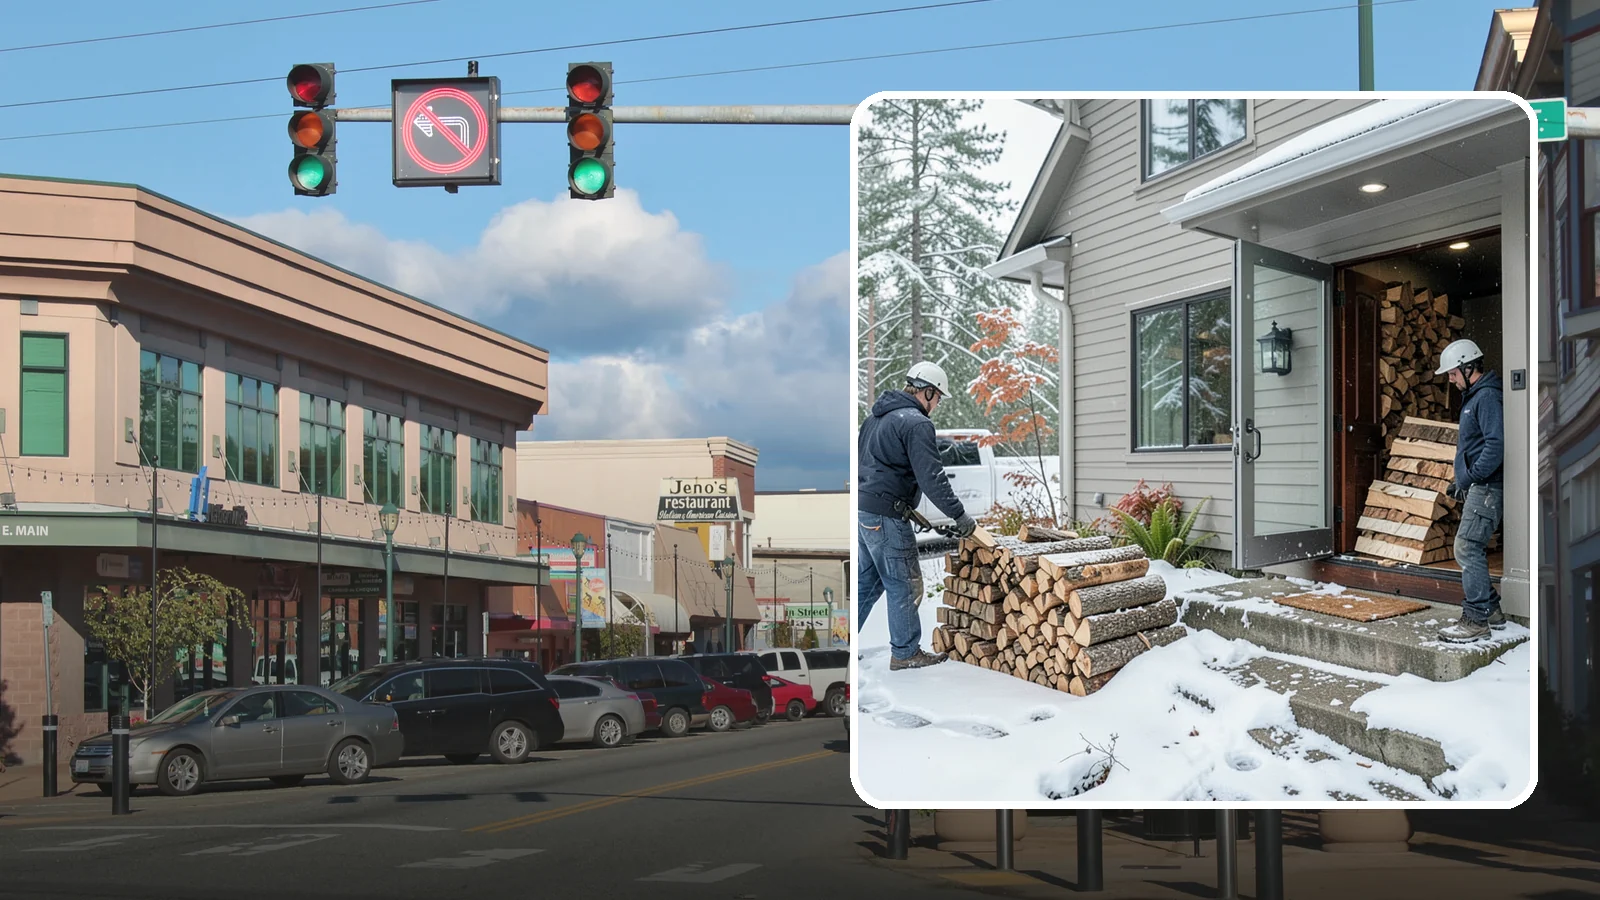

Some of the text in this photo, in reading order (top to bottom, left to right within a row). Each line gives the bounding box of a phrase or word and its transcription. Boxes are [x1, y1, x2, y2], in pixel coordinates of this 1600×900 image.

[670, 480, 727, 494] Jeno's
[665, 496, 731, 509] restaurant
[658, 509, 682, 520] Italian
[686, 509, 715, 519] American
[715, 509, 737, 519] Cuisine
[2, 525, 49, 536] E. MAIN
[797, 607, 829, 617] Street
